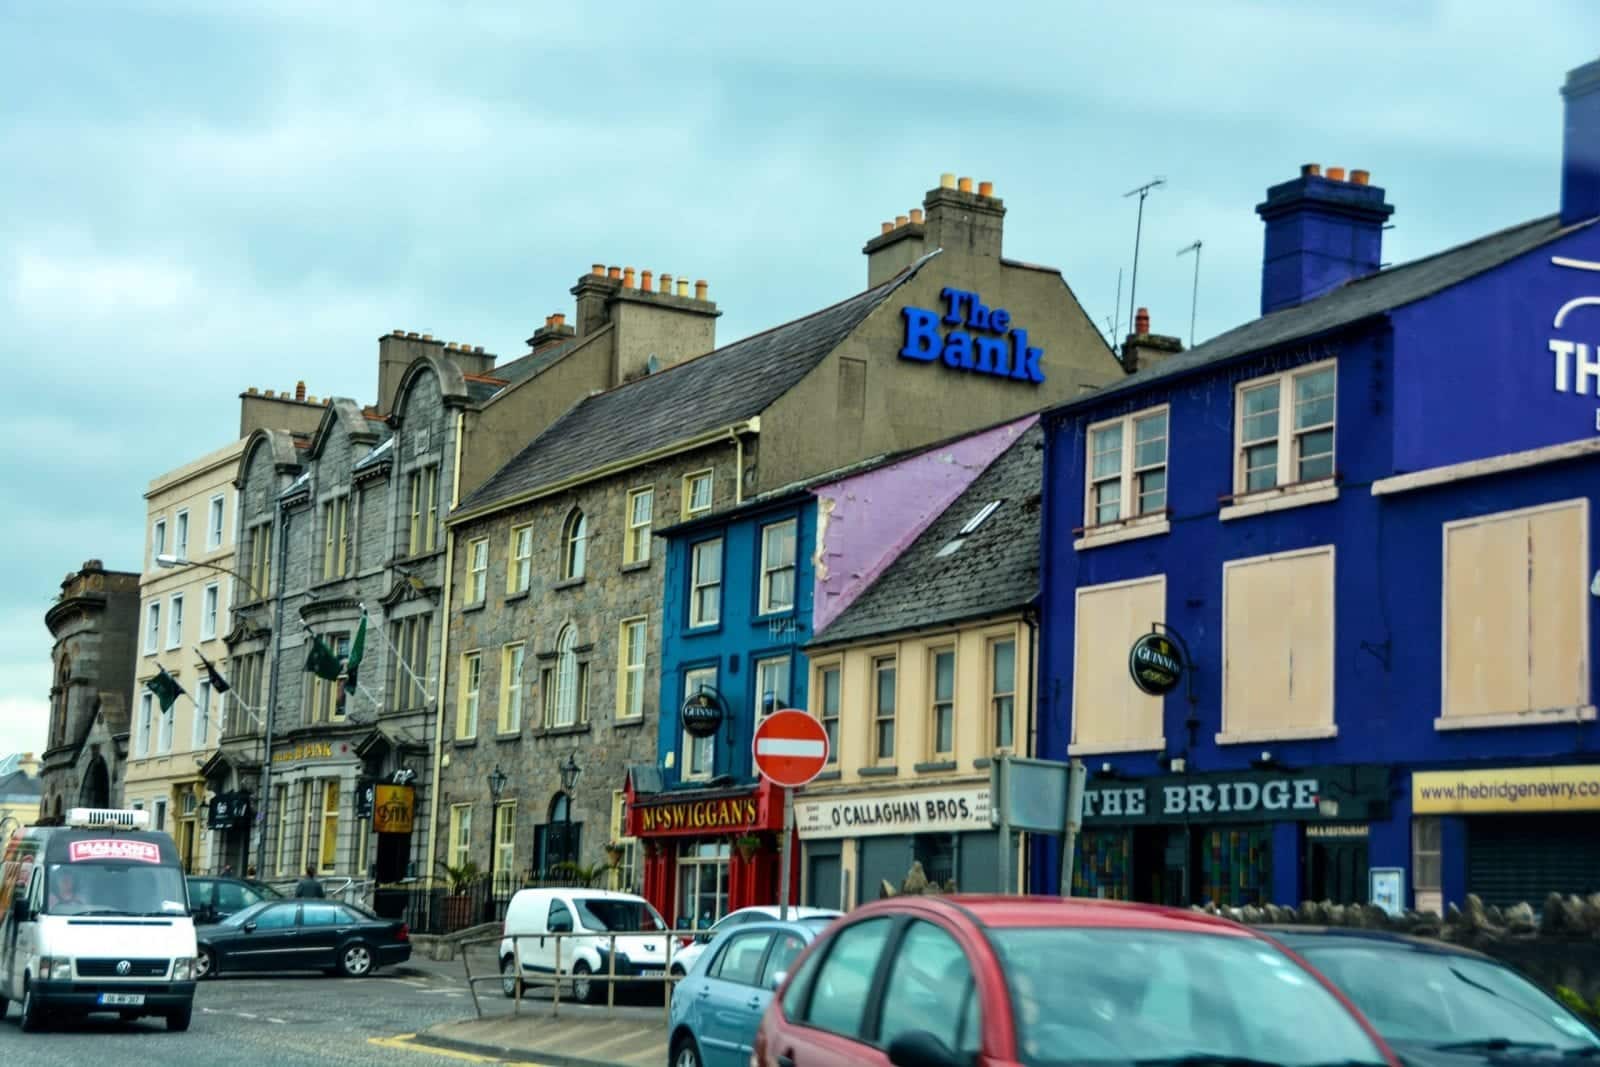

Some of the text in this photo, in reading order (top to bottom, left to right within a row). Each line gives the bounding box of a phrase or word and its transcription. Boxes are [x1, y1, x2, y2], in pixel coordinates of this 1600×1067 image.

[940, 286, 1011, 334] The
[900, 305, 1046, 384] Bank
[684, 705, 720, 718] GUINN
[832, 800, 921, 827] O'CALLAGHAN
[925, 797, 974, 821] BROS.
[1082, 778, 1319, 817] THE BRIDGE
